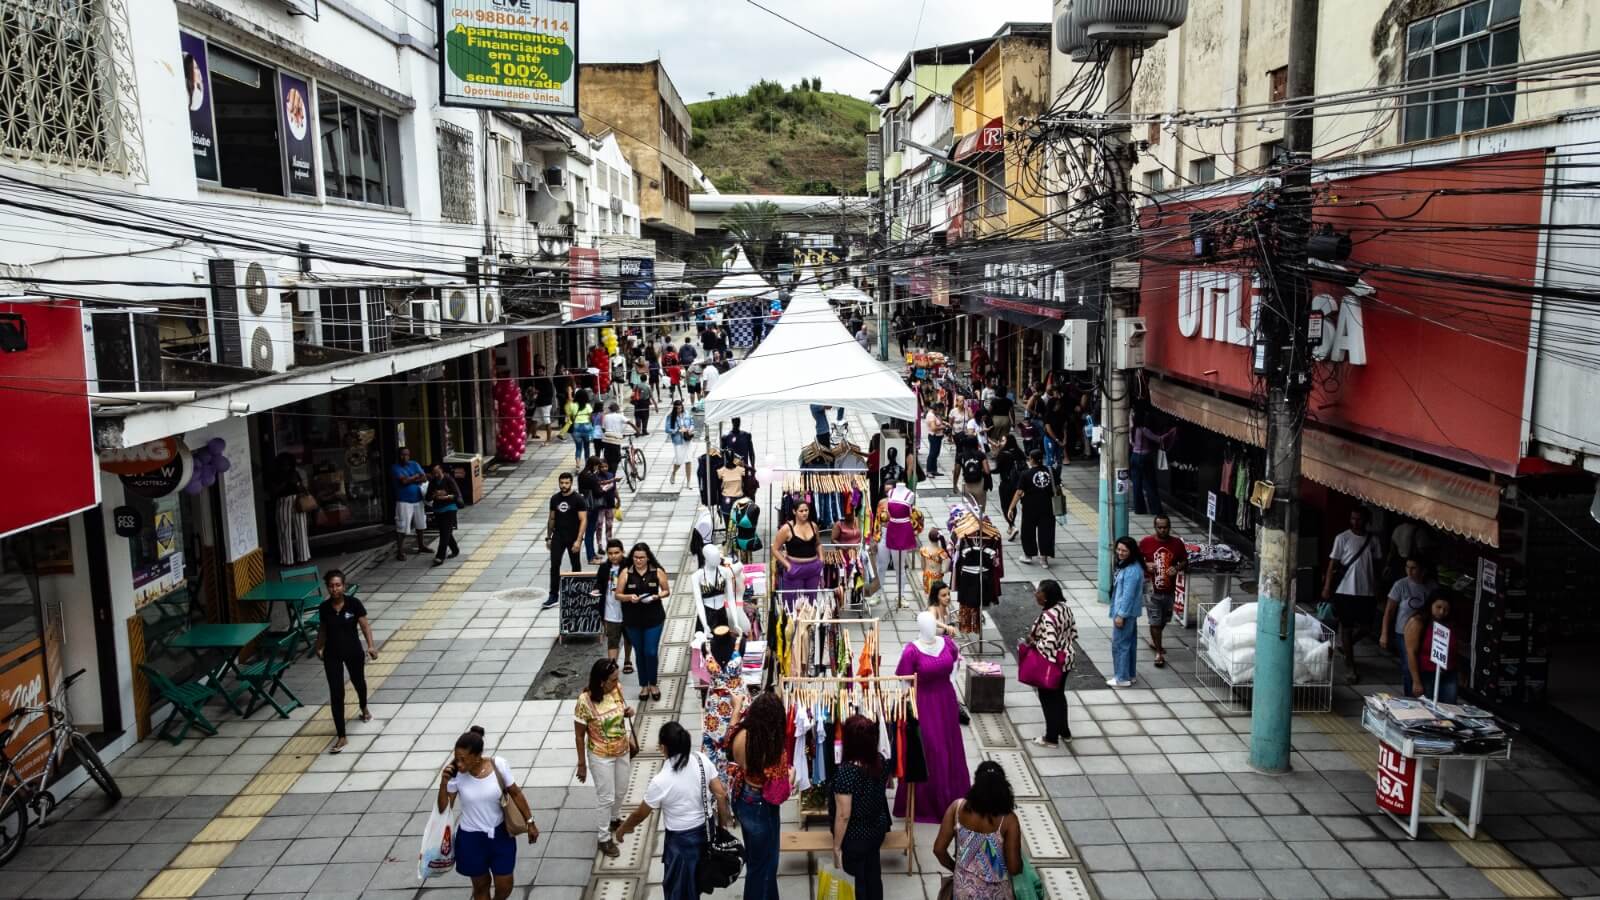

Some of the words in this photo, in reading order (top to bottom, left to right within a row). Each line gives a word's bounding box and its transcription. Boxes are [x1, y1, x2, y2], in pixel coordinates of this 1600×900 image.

[475, 9, 569, 32] 98804-7114
[454, 22, 565, 45] Apartamentos
[467, 36, 560, 56] Financiados
[488, 51, 511, 60] em
[516, 52, 540, 63] até
[491, 62, 548, 80] 100%
[466, 73, 498, 84] sem
[503, 76, 561, 89] entrada
[463, 85, 530, 100] Oportunidade
